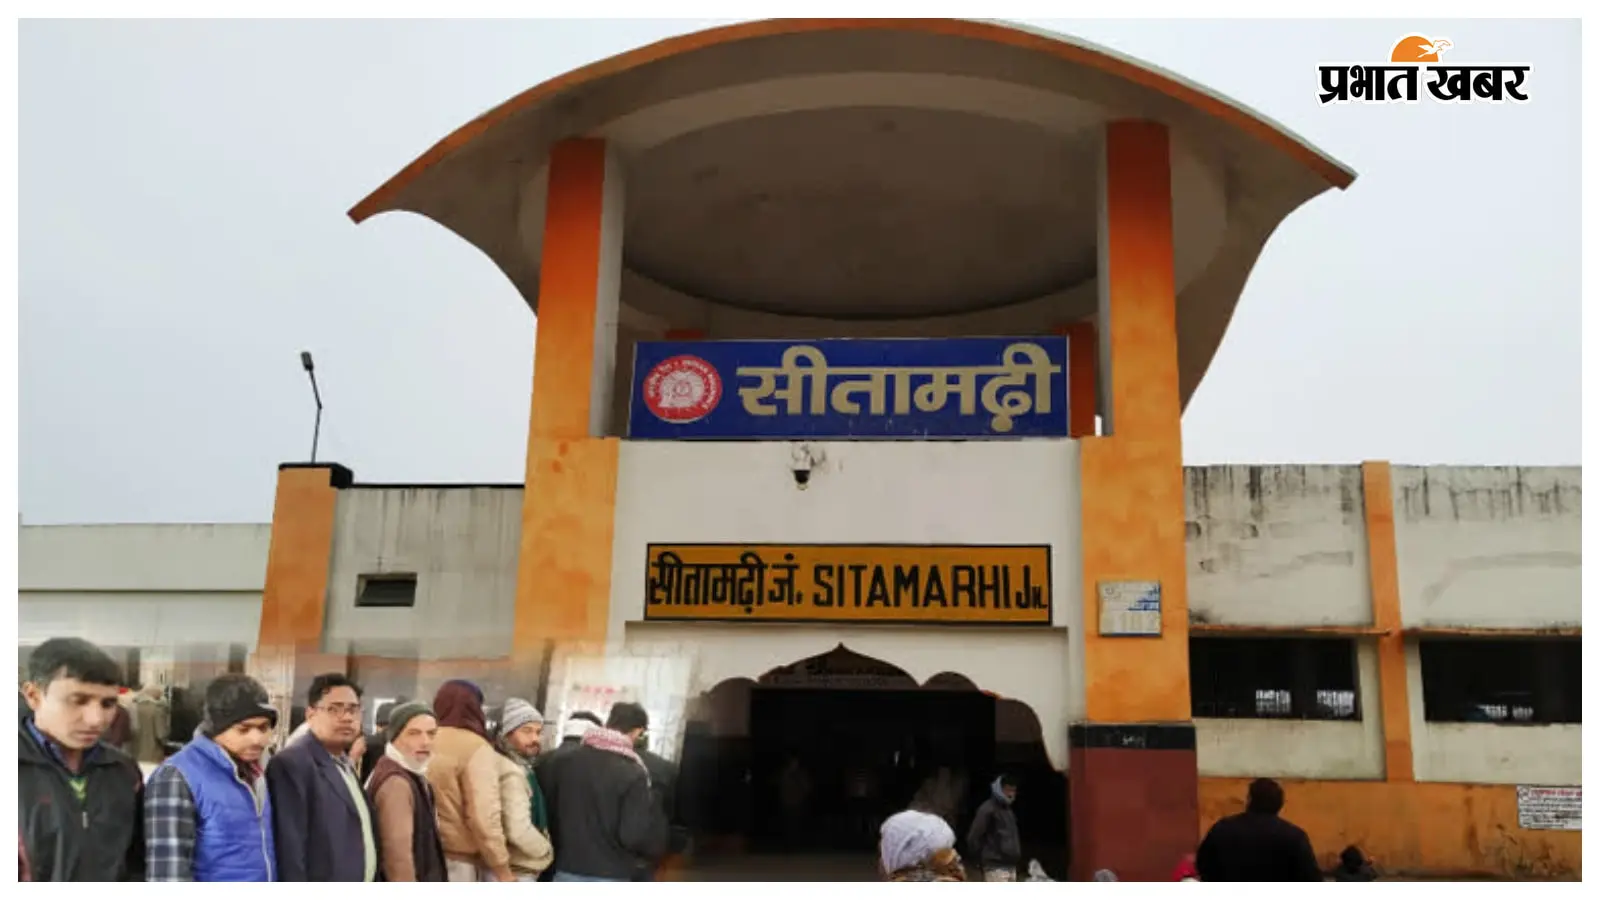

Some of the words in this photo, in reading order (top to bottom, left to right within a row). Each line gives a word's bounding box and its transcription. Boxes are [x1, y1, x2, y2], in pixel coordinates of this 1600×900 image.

[736, 343, 1061, 432] सीतामढ़ी
[648, 551, 768, 615] सीतामढ़ी
[813, 563, 1011, 609] SITAMARHI
